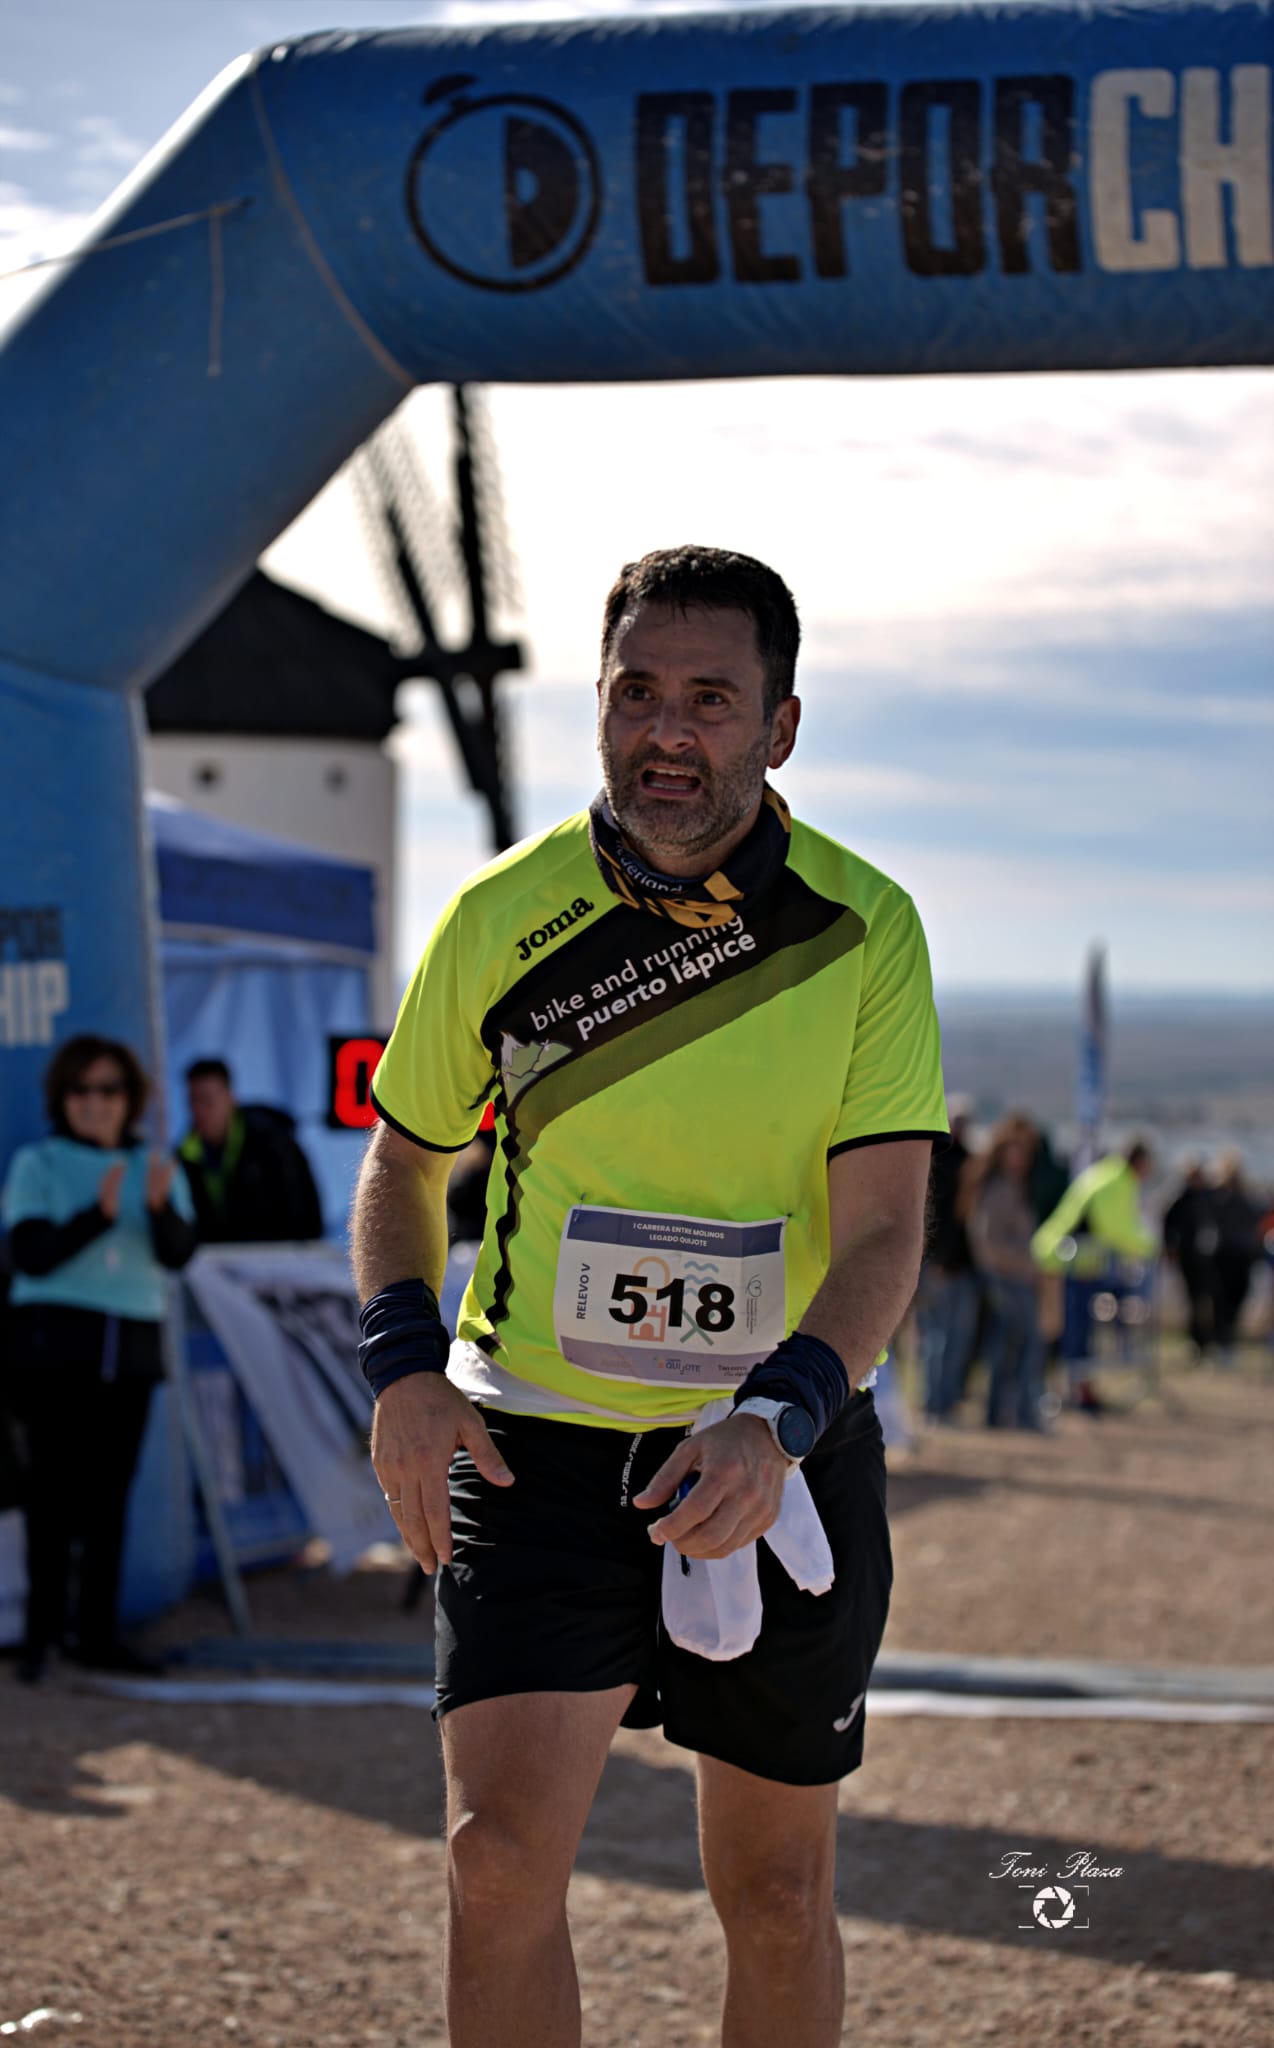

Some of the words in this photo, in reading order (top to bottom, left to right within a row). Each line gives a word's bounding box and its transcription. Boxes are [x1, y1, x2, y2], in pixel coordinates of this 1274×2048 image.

[515, 897, 595, 961] Joma
[530, 993, 586, 1032] bike
[590, 958, 639, 1000] and
[576, 977, 667, 1041] puerto
[669, 933, 757, 985] lápice
[637, 1223, 671, 1233] CARRERA
[671, 1226, 693, 1236] ENTRE
[693, 1228, 726, 1240] MOLINOS
[649, 1234, 679, 1242] LEGADO
[679, 1236, 709, 1247] QUIJOTE
[581, 1262, 591, 1272] V
[576, 1274, 590, 1320] RELEVO
[608, 1273, 735, 1333] 518
